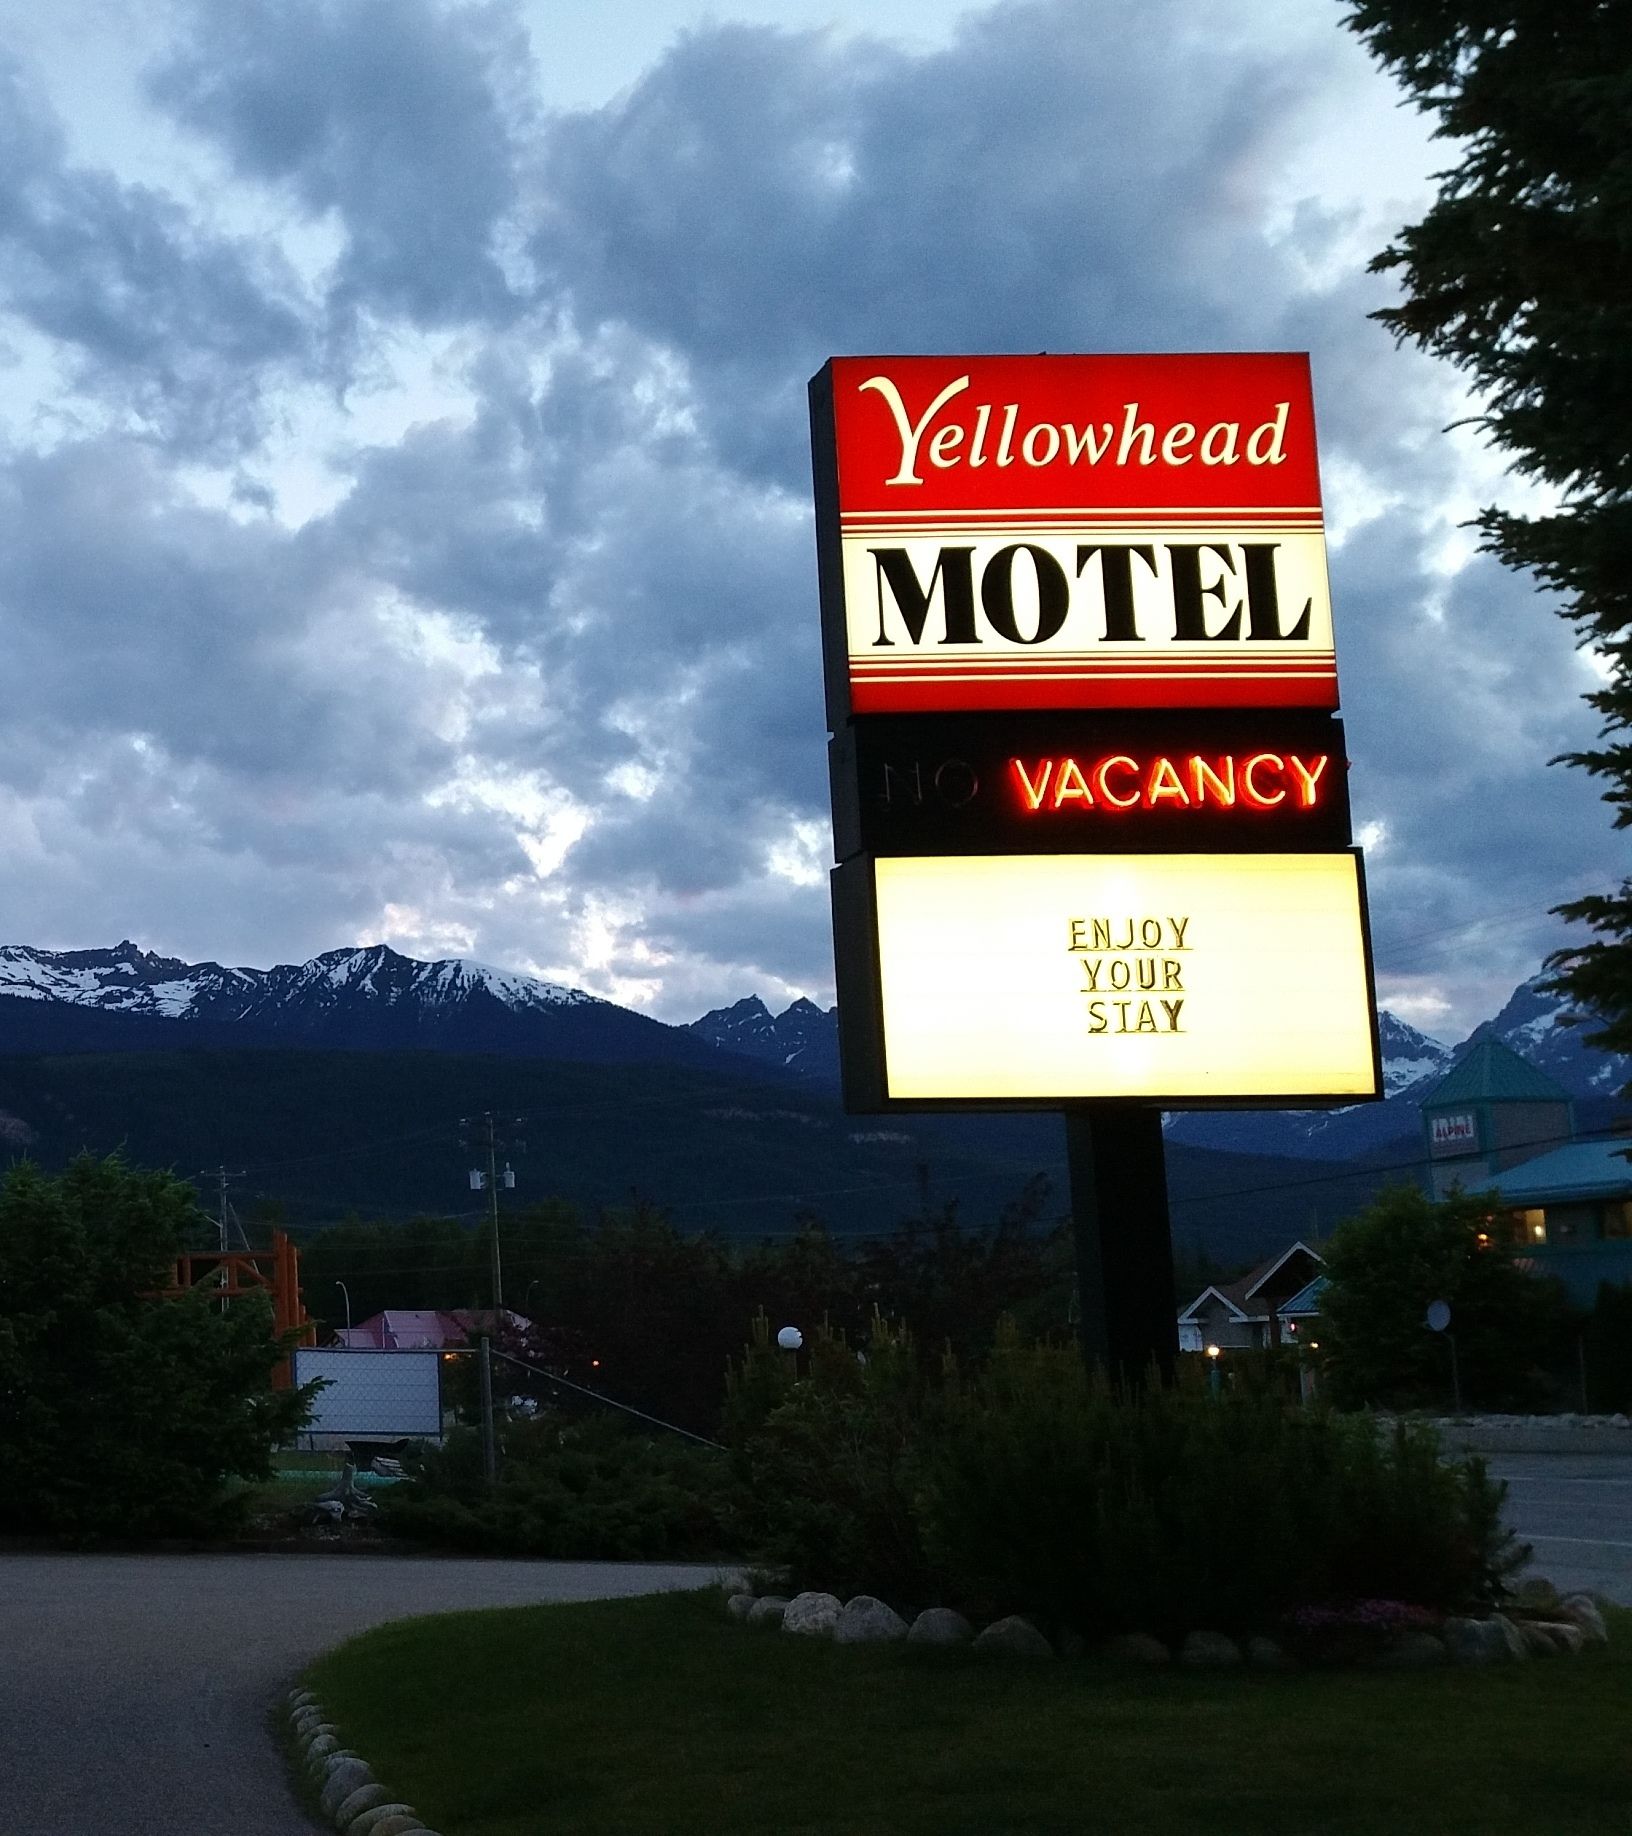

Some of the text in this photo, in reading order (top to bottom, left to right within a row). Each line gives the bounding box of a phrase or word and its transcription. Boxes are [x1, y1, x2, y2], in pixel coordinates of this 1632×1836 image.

[858, 375, 1290, 486] Yellowhead
[867, 543, 1312, 647] MOTEL
[1011, 753, 1328, 809] VACANCY
[1068, 917, 1192, 951] ENJOY
[1080, 958, 1185, 992] YOUR
[1088, 999, 1186, 1033] STAY
